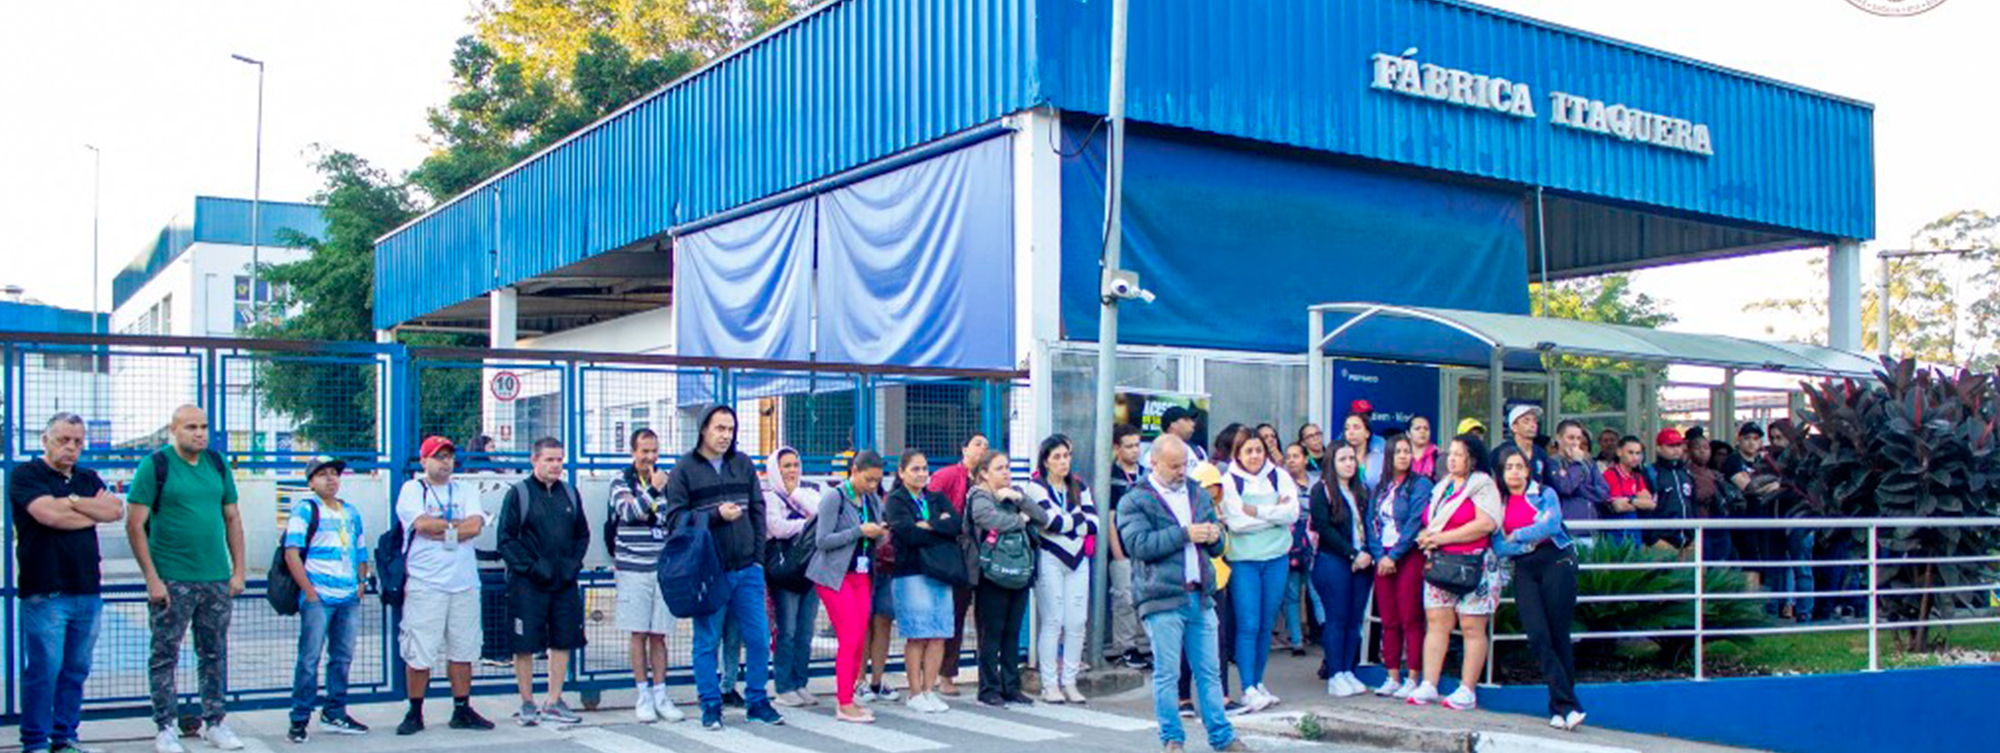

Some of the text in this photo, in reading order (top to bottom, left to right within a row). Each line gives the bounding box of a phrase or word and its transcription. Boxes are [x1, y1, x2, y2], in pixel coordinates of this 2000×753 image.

[1371, 47, 1714, 155] FÁBRICA ITAQUERA
[496, 376, 514, 391] 10
